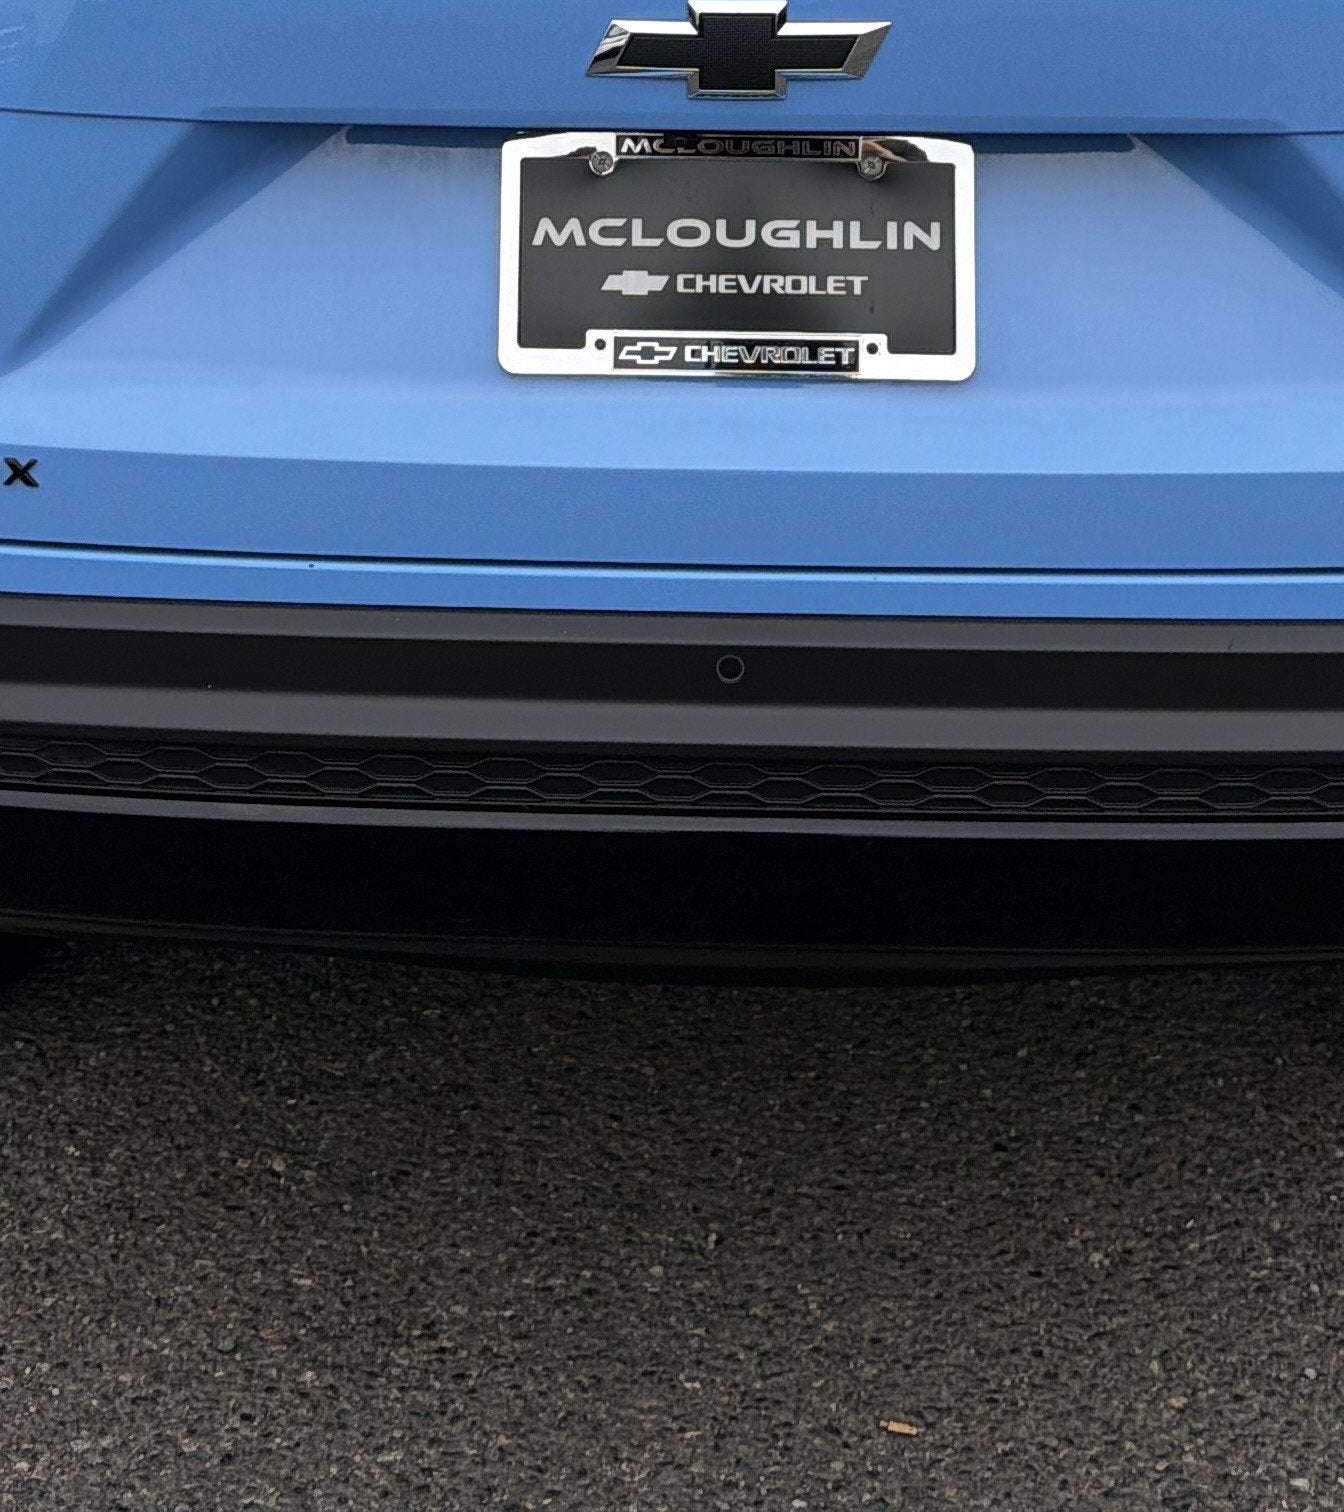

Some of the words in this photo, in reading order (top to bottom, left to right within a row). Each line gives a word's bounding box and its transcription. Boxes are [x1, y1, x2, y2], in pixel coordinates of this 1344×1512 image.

[621, 138, 856, 158] MCLOUGHLIN
[532, 217, 941, 251] MCLOUGHLIN
[676, 272, 869, 296] CHEVROLET
[684, 343, 855, 365] CHEVROLET
